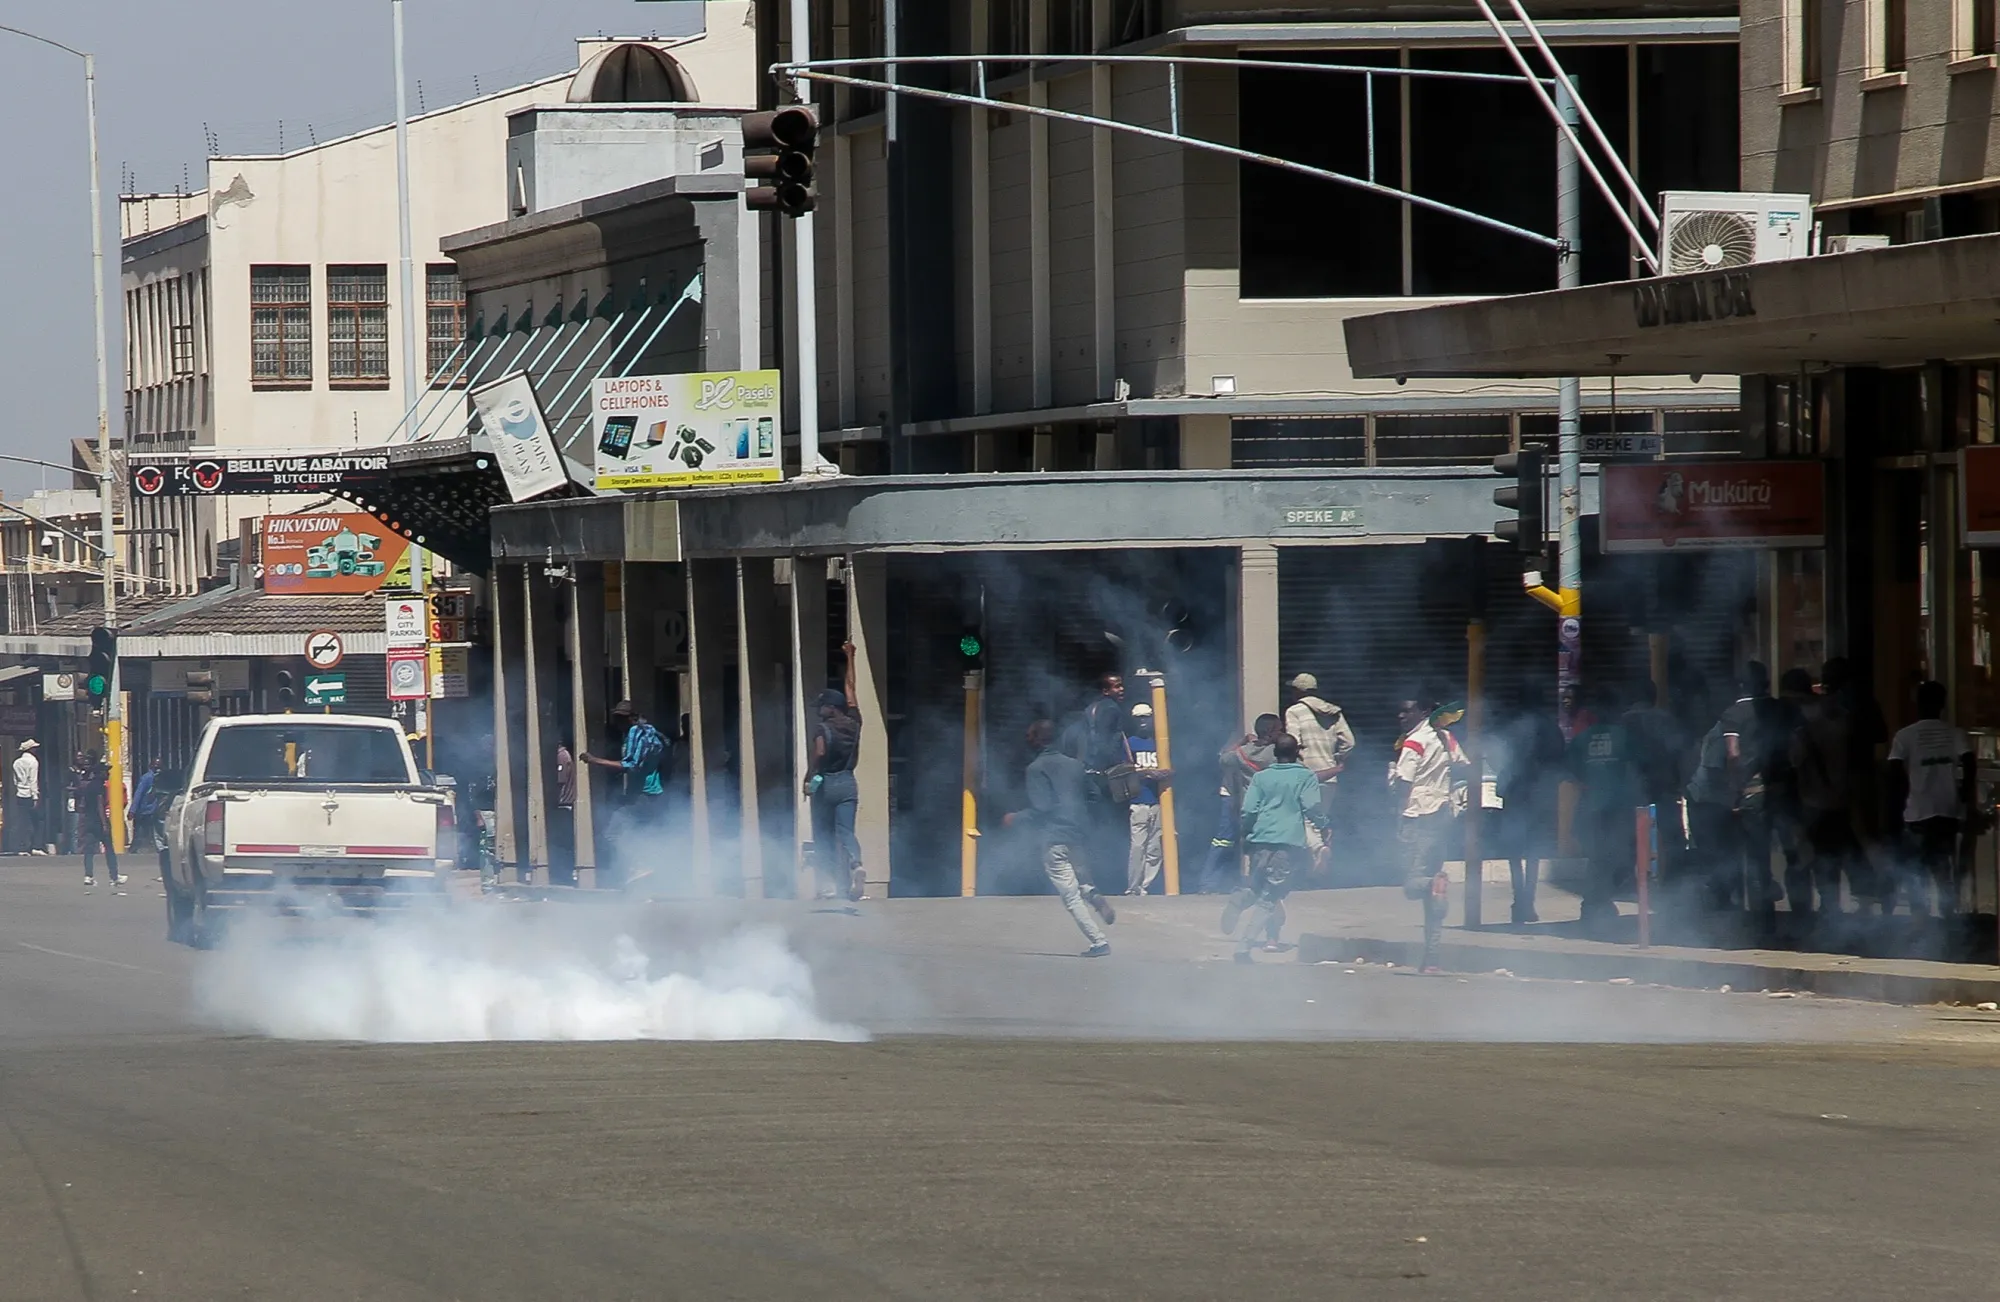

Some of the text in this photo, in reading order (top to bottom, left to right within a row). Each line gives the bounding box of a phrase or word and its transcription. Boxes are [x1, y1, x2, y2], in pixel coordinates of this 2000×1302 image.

[605, 379, 662, 394] LAPTOPS &
[600, 395, 669, 411] CELLPHONES
[1586, 438, 1632, 452] SPEKE
[513, 443, 533, 475] PLAN
[529, 436, 552, 472] PAINT
[227, 457, 388, 473] BELLEVUE ABATTOIR
[273, 473, 343, 485] BUTCHERY
[1286, 510, 1333, 523] SPEKE
[267, 517, 341, 533] HIKVISION
[267, 534, 286, 545] No.1
[390, 629, 422, 637] PARKING
[329, 695, 345, 703] WAY
[1133, 751, 1158, 768] JUS
